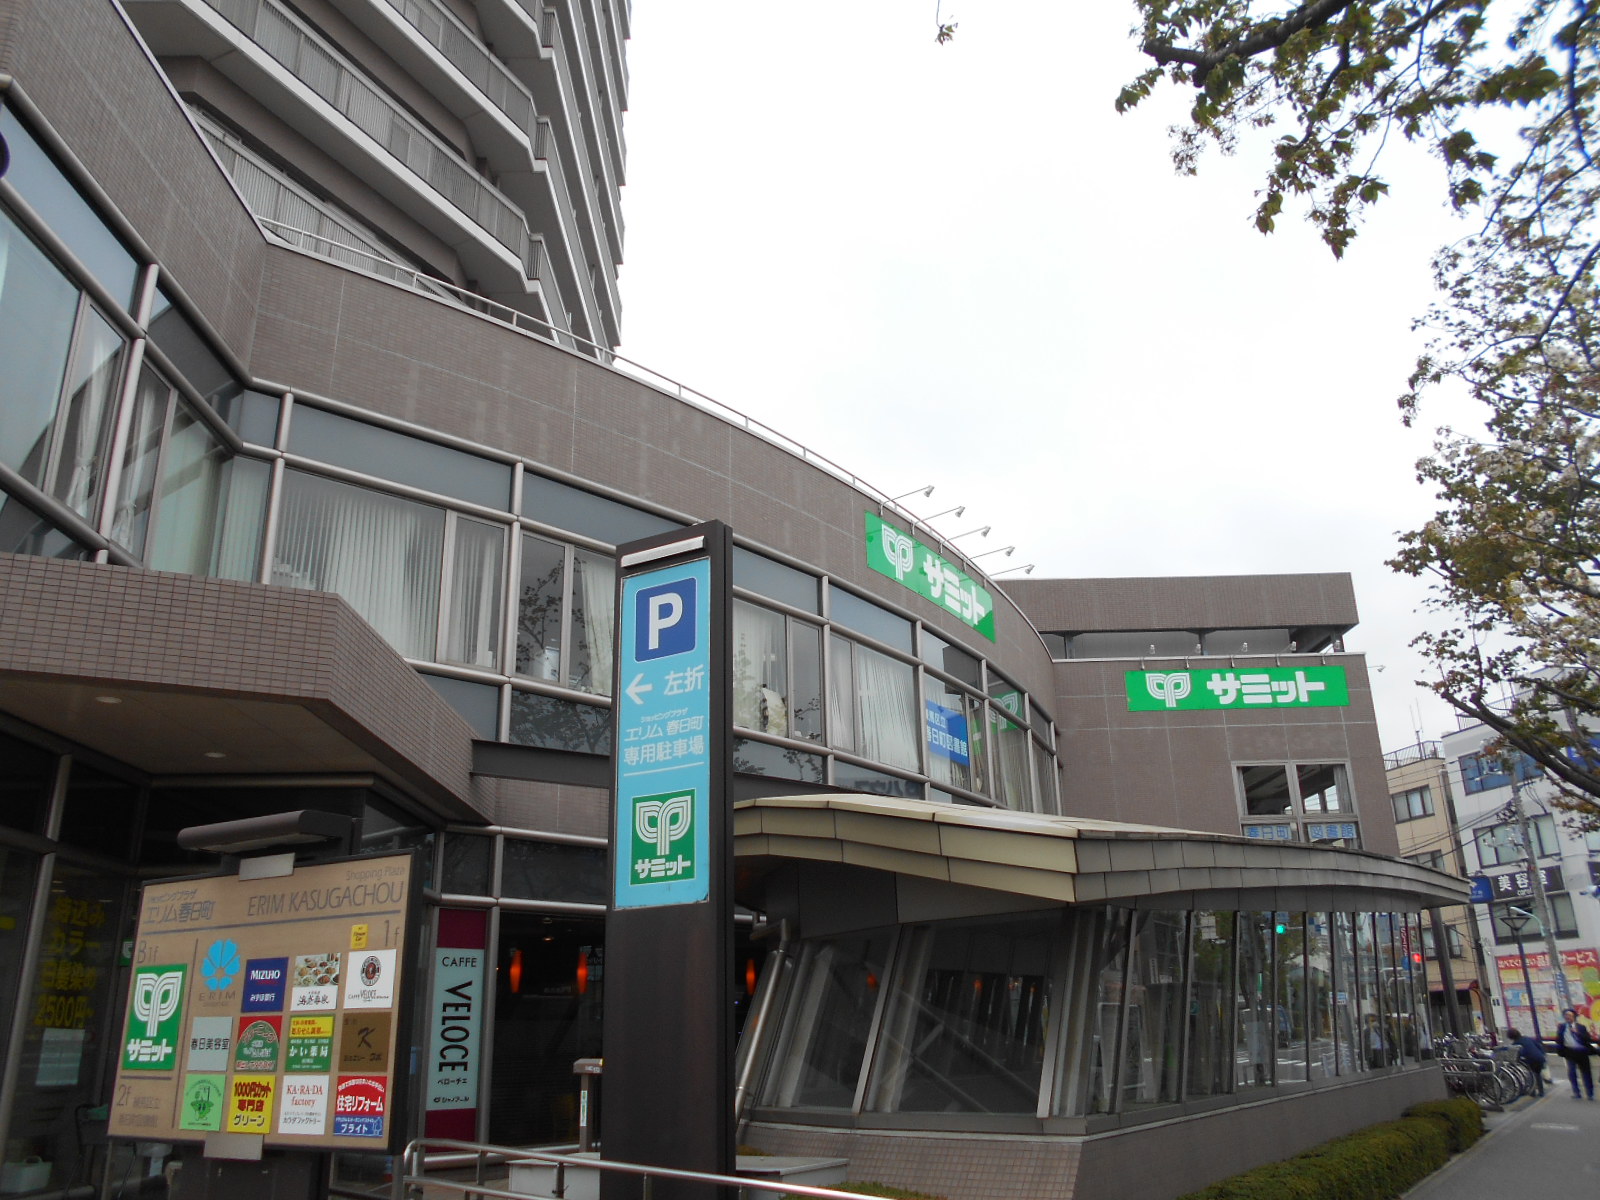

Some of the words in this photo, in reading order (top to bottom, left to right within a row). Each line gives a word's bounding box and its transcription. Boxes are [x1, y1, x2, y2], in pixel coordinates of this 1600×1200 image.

[922, 553, 985, 627] サミット
[648, 592, 684, 650] P
[663, 664, 705, 696] 左折
[1206, 672, 1326, 705] サミット
[623, 735, 705, 767] 専用駐車場
[634, 853, 692, 879] サミット
[247, 893, 285, 917] ERIM
[288, 880, 405, 912] KASUGACHOU
[441, 956, 477, 969] CAFFE
[250, 969, 281, 981] MIZUHO
[198, 991, 237, 1002] ERIM
[438, 980, 473, 1073] VELOCE
[126, 1038, 173, 1063] サミット
[191, 1037, 231, 1051] 春日美容室
[289, 1045, 329, 1058] かい薬局
[233, 1081, 272, 1099] 1000円カット
[237, 1098, 266, 1113] 専門店
[291, 1096, 317, 1109] factory
[336, 1094, 384, 1112] 住宅リフォーム
[233, 1113, 266, 1128] グリーン
[340, 1122, 369, 1134] ブライト
